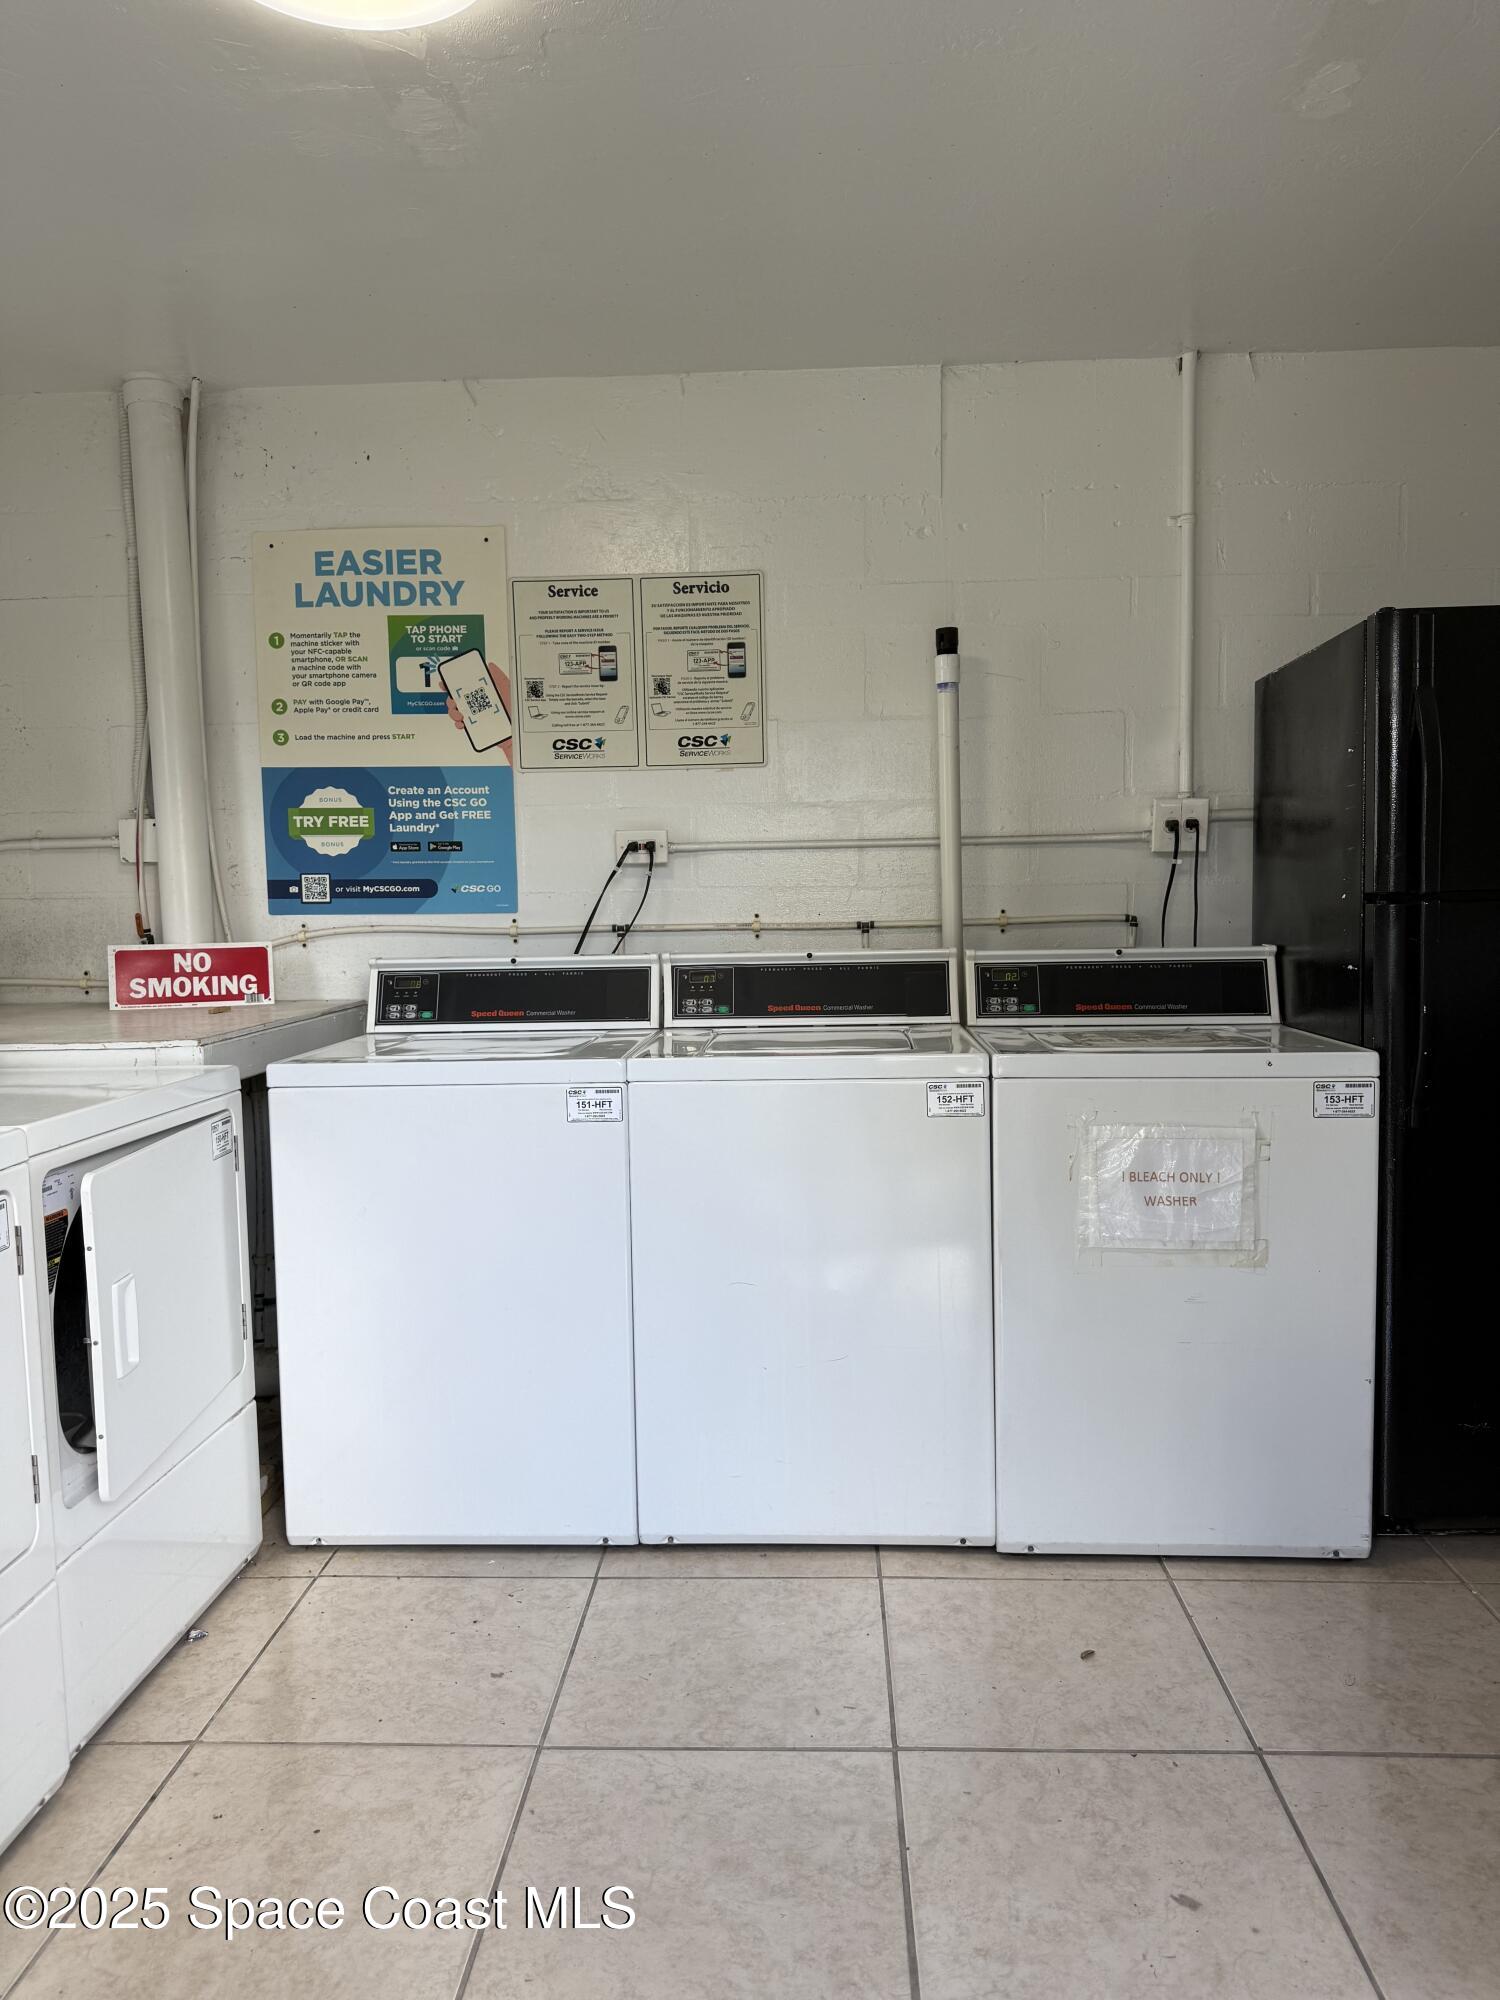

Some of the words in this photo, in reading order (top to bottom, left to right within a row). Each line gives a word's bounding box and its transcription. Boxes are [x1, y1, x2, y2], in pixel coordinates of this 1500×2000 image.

[314, 548, 443, 577] EASIER
[547, 584, 599, 598] Service
[672, 580, 730, 595] Servicio
[294, 580, 465, 608] LAUNDRY
[405, 625, 427, 634] TAP
[428, 624, 468, 634] PHONE
[272, 635, 279, 646] 1
[290, 632, 332, 640] Momentarily
[410, 634, 426, 643] TO
[428, 634, 463, 643] START
[307, 648, 352, 656] NFC-capable
[291, 656, 334, 664] smartphone,
[308, 672, 350, 680] smartphone
[276, 703, 284, 712] 2
[277, 733, 285, 743] 3
[677, 735, 718, 748] CSC
[552, 738, 592, 751] CSC
[387, 785, 424, 795] Create
[427, 787, 441, 795] an
[444, 785, 490, 795] Account
[388, 798, 420, 809] Using
[422, 798, 441, 808] the
[444, 798, 467, 807] CSC
[469, 798, 488, 807] GO
[389, 811, 412, 822] App
[415, 810, 437, 820] and
[439, 810, 459, 820] Get
[461, 810, 492, 820] FREE
[293, 815, 324, 828] TRY
[328, 815, 369, 828] FREE
[345, 885, 361, 893] visit
[362, 885, 420, 894] MyCSCGO.com
[460, 884, 485, 893] CSC
[486, 884, 502, 893] GO
[173, 952, 212, 973] NO
[129, 974, 258, 999] SMOKING
[767, 1004, 794, 1012] Speed
[1075, 1003, 1103, 1012] Speed
[1104, 1003, 1133, 1011] Queen
[471, 1010, 497, 1018] Speed
[498, 1009, 525, 1017] Queen
[937, 1095, 975, 1103] 152-HFT
[1324, 1095, 1364, 1104] 153-HFT
[576, 1100, 613, 1109] 151-HFT
[1129, 1171, 1176, 1183] BLEACH
[1179, 1172, 1213, 1183] ONLY
[1143, 1196, 1198, 1207] WASHER
